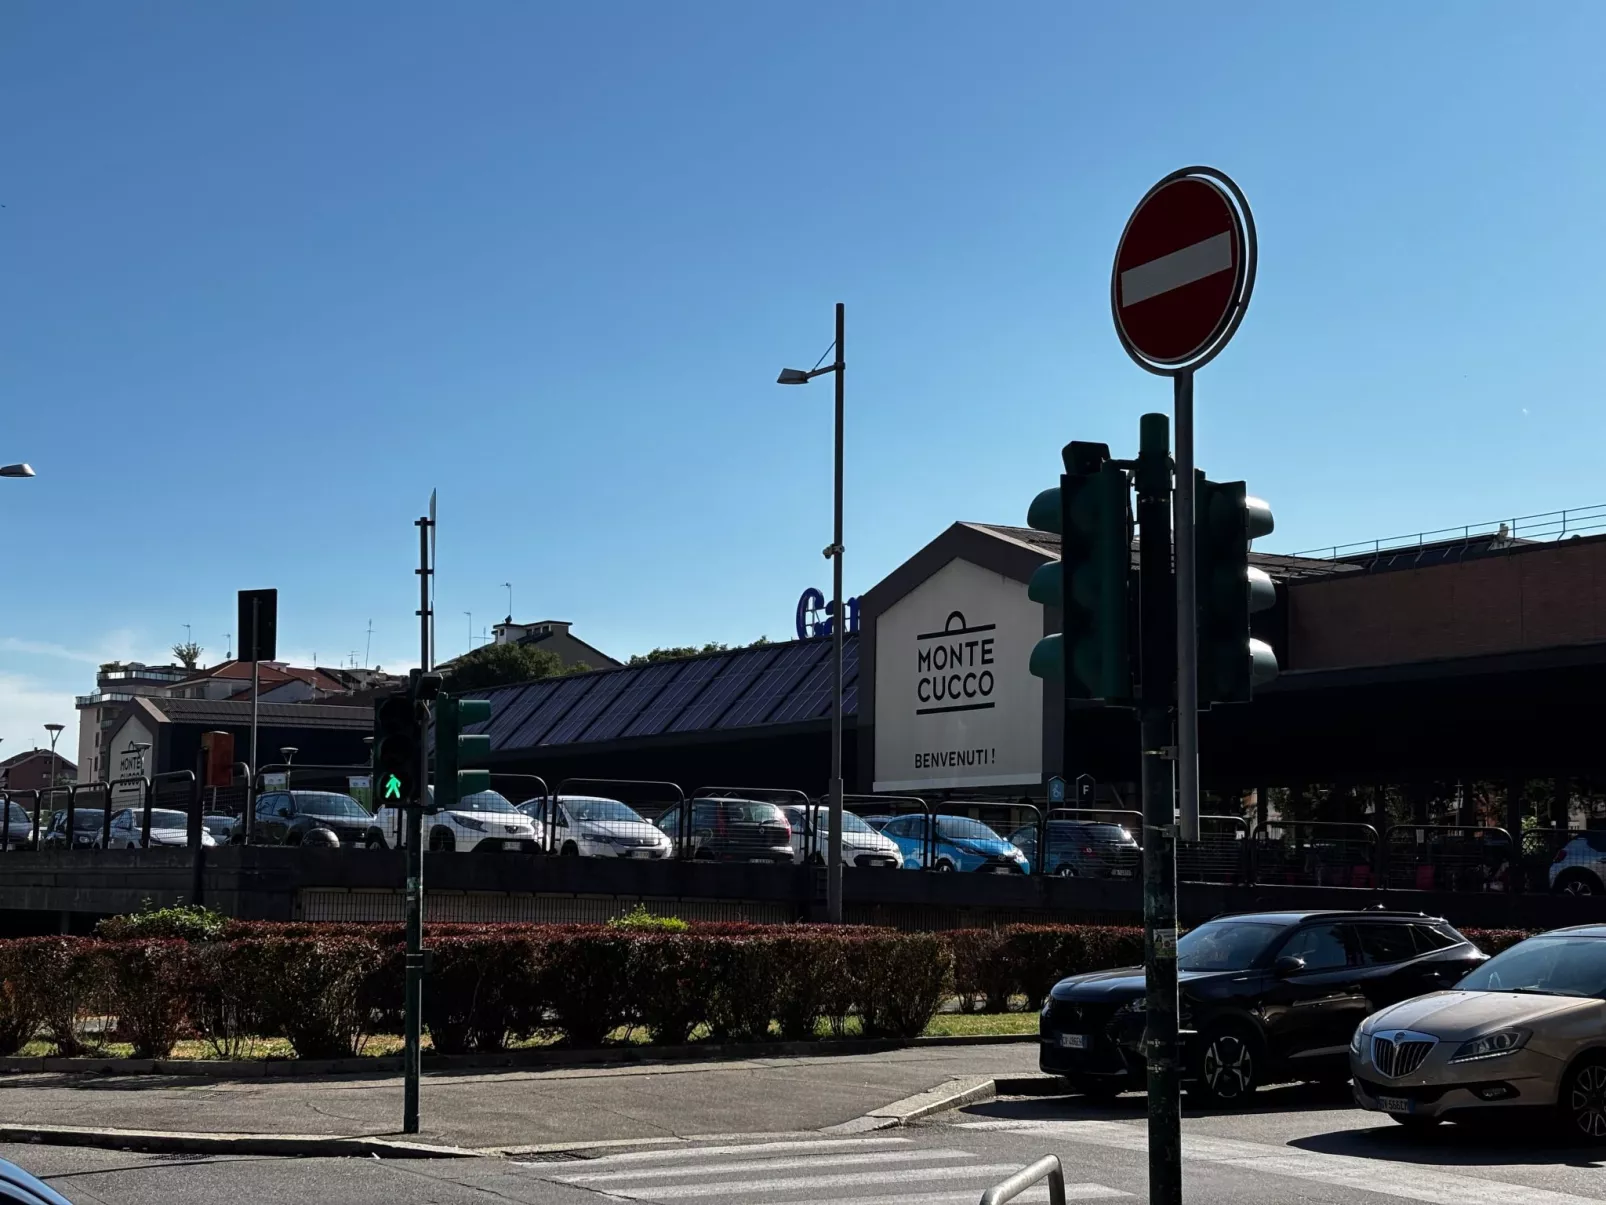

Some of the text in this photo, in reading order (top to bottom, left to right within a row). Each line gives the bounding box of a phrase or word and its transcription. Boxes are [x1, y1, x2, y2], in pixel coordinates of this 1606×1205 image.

[918, 638, 994, 673] MONTE
[917, 670, 994, 702] CUCCO
[120, 756, 141, 771] MONTE
[1083, 785, 1090, 795] F
